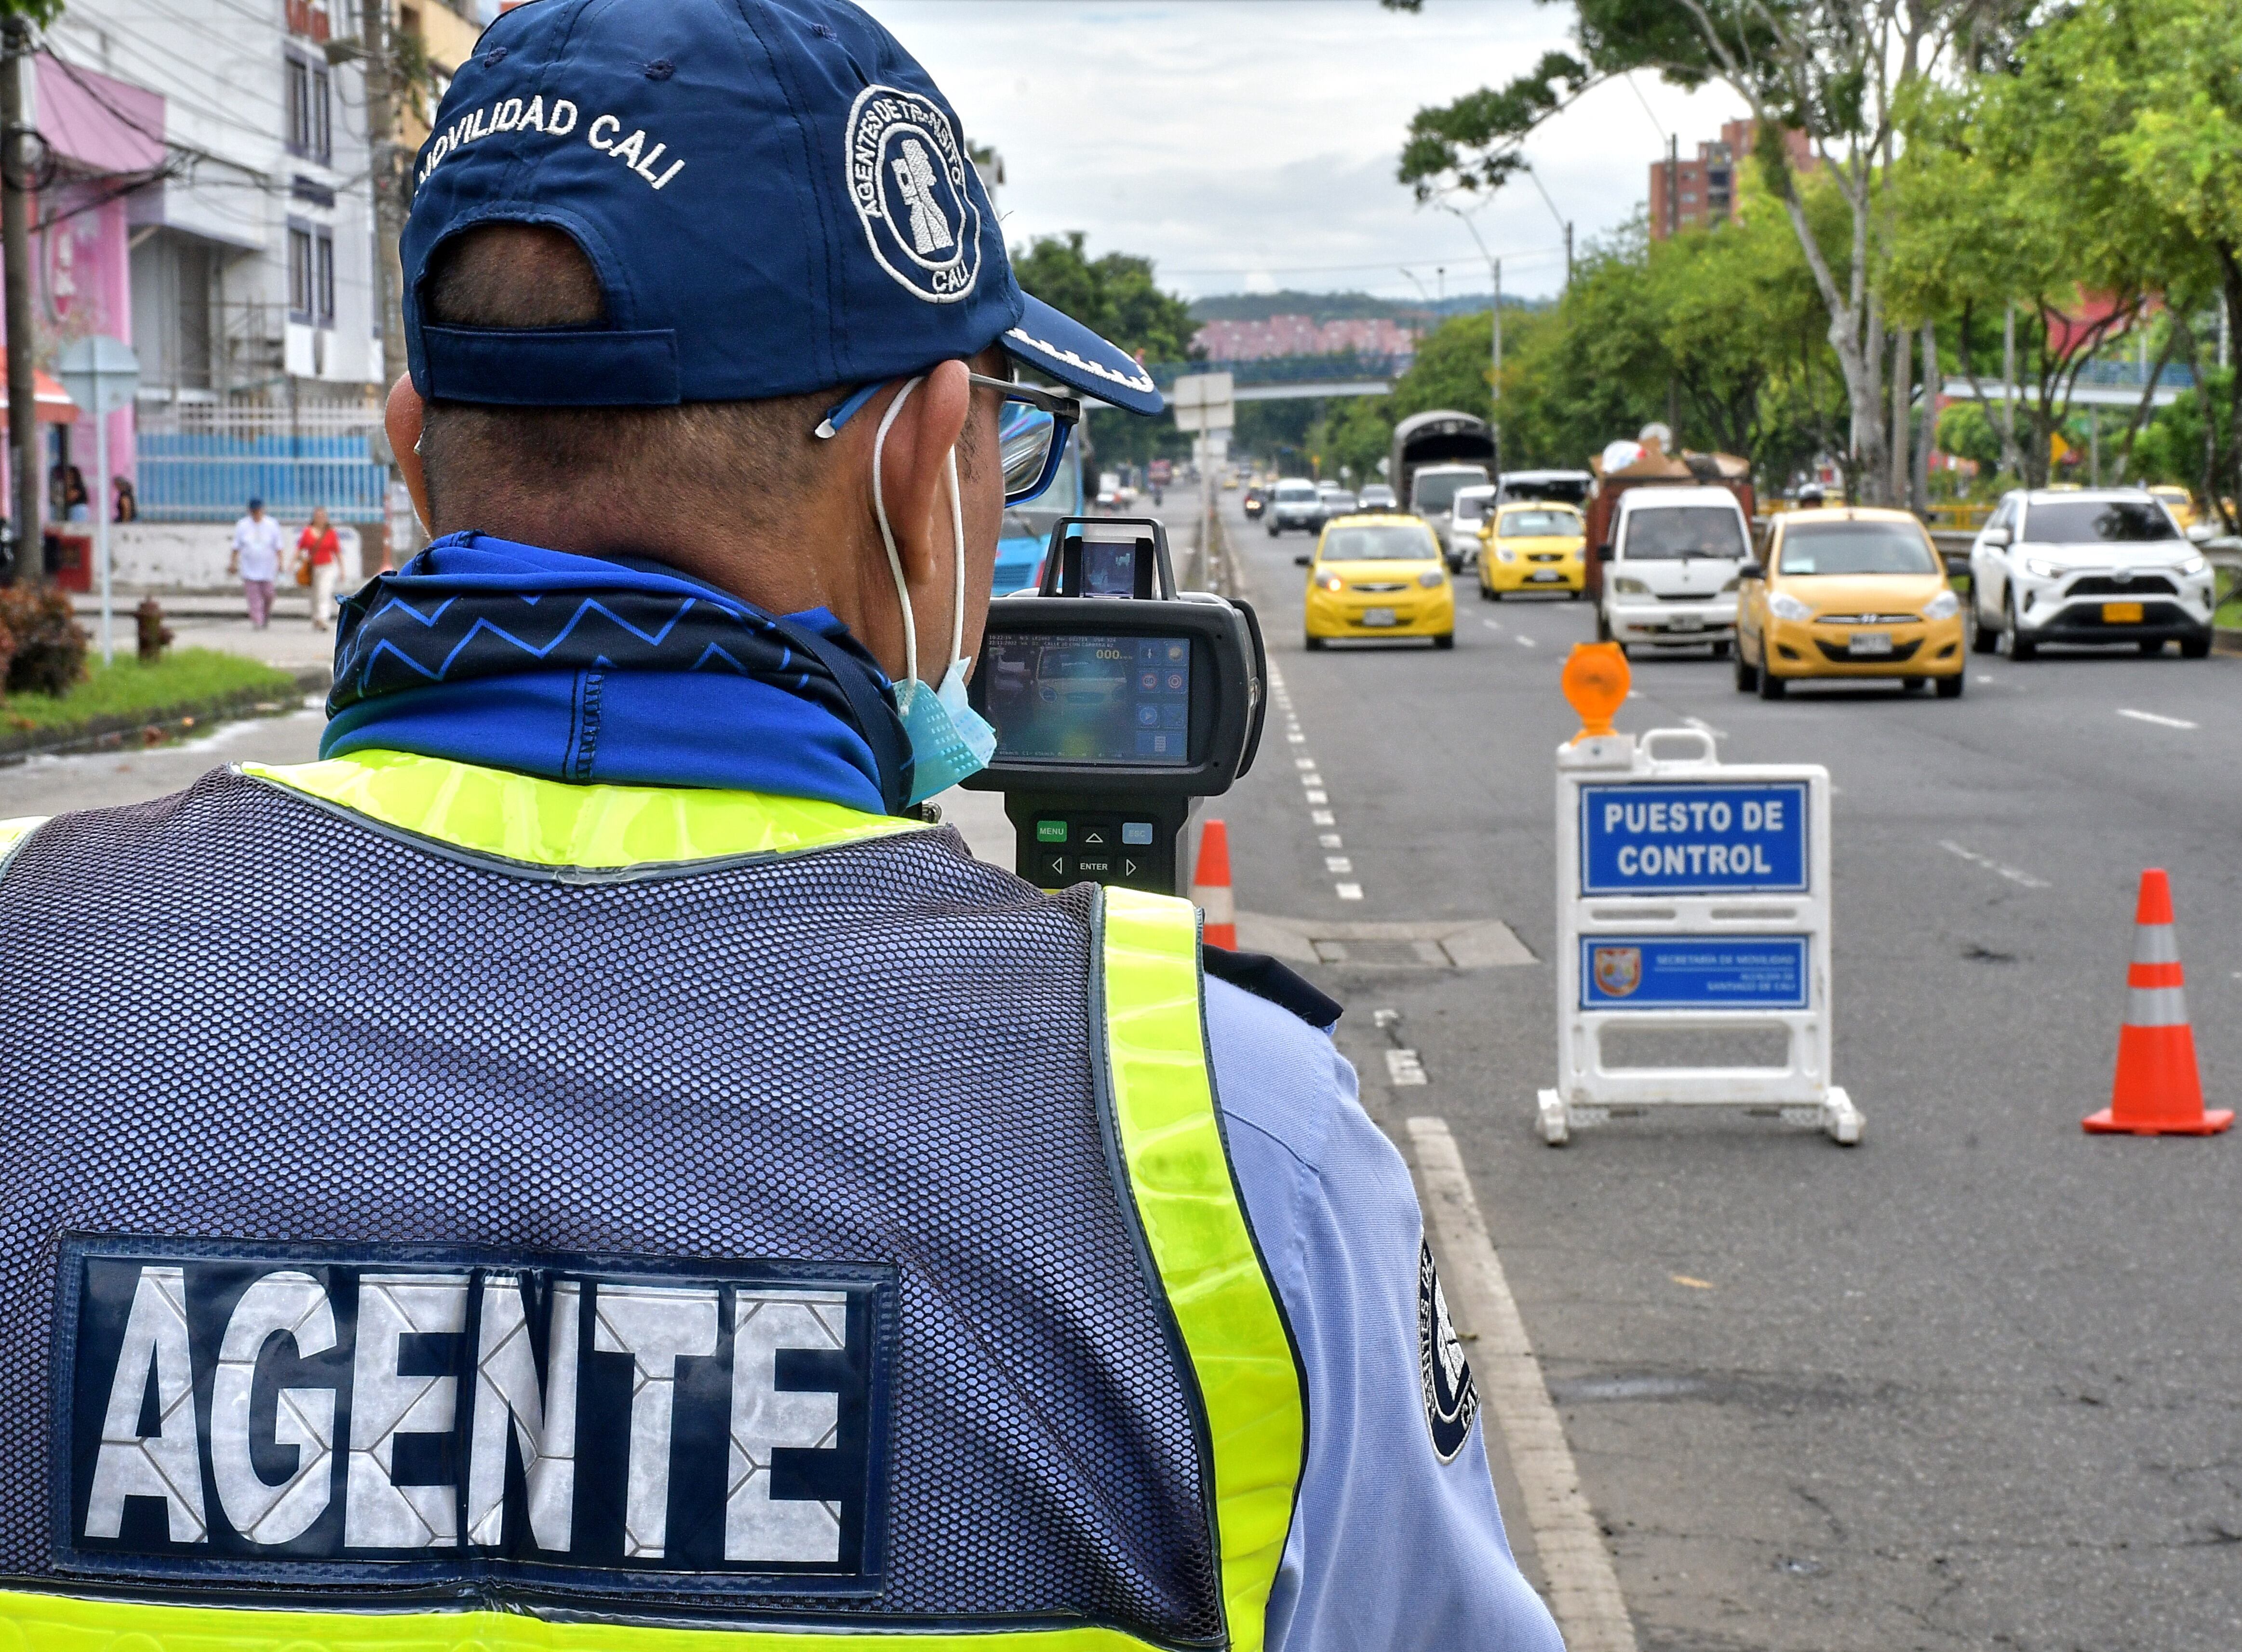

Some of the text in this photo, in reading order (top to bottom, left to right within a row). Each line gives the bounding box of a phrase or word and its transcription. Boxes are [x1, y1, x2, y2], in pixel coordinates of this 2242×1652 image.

[588, 115, 685, 190] CALI
[855, 110, 884, 218] AGENTES
[873, 98, 902, 122] DE
[932, 259, 970, 292] CALI
[1096, 649, 1119, 660] 000
[1040, 827, 1064, 835] MENU
[1604, 801, 1784, 833] PUESTO DE
[1080, 862, 1108, 871] ENTER
[1617, 845, 1772, 875] CONTROL
[84, 1266, 847, 1562] AGENTE
